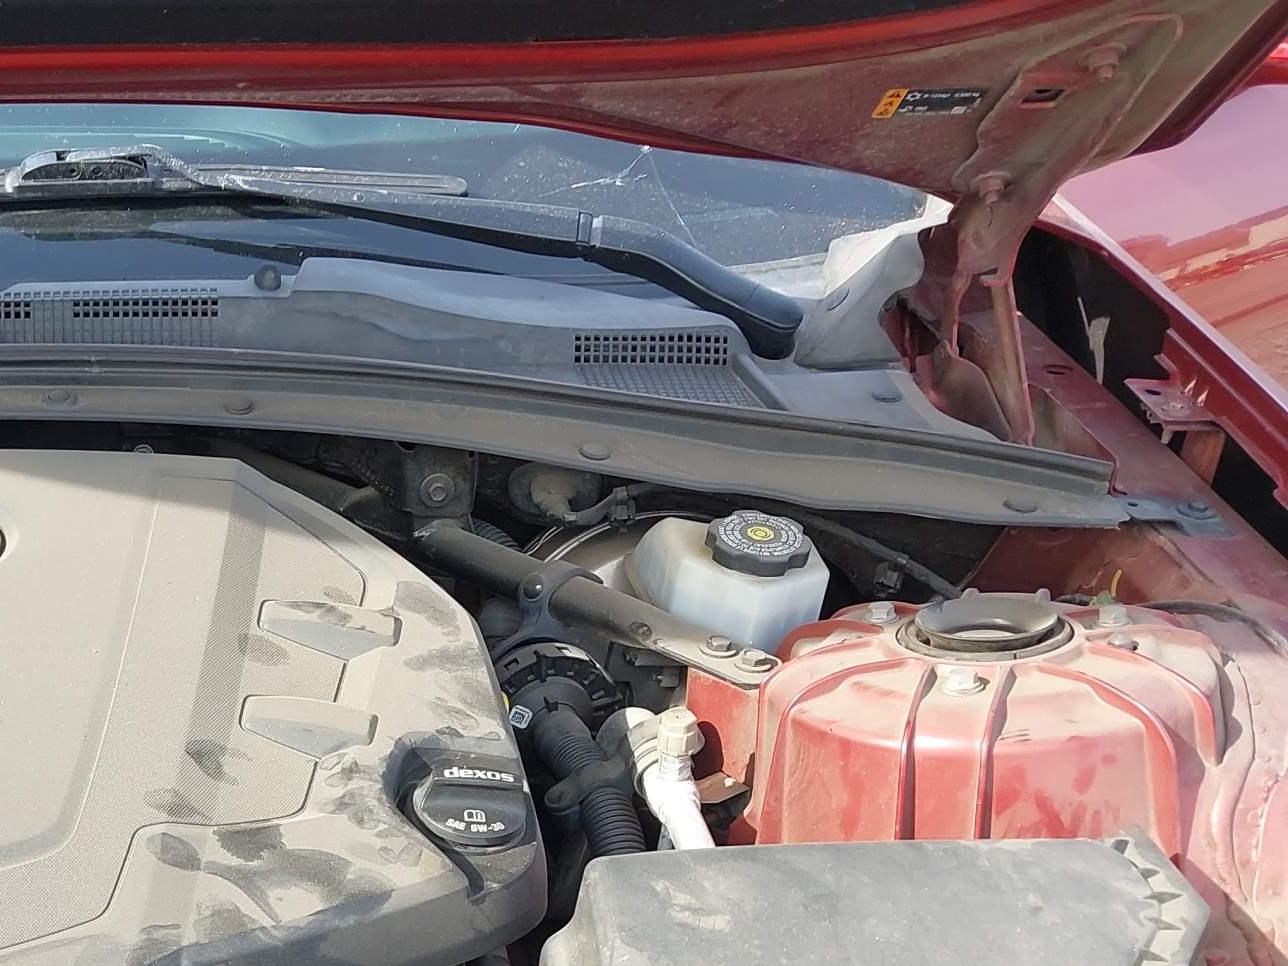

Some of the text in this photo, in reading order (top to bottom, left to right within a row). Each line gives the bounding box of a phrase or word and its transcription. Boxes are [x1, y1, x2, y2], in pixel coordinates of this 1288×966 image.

[443, 766, 515, 783] dexos
[445, 818, 505, 833] SAE 5W-30
